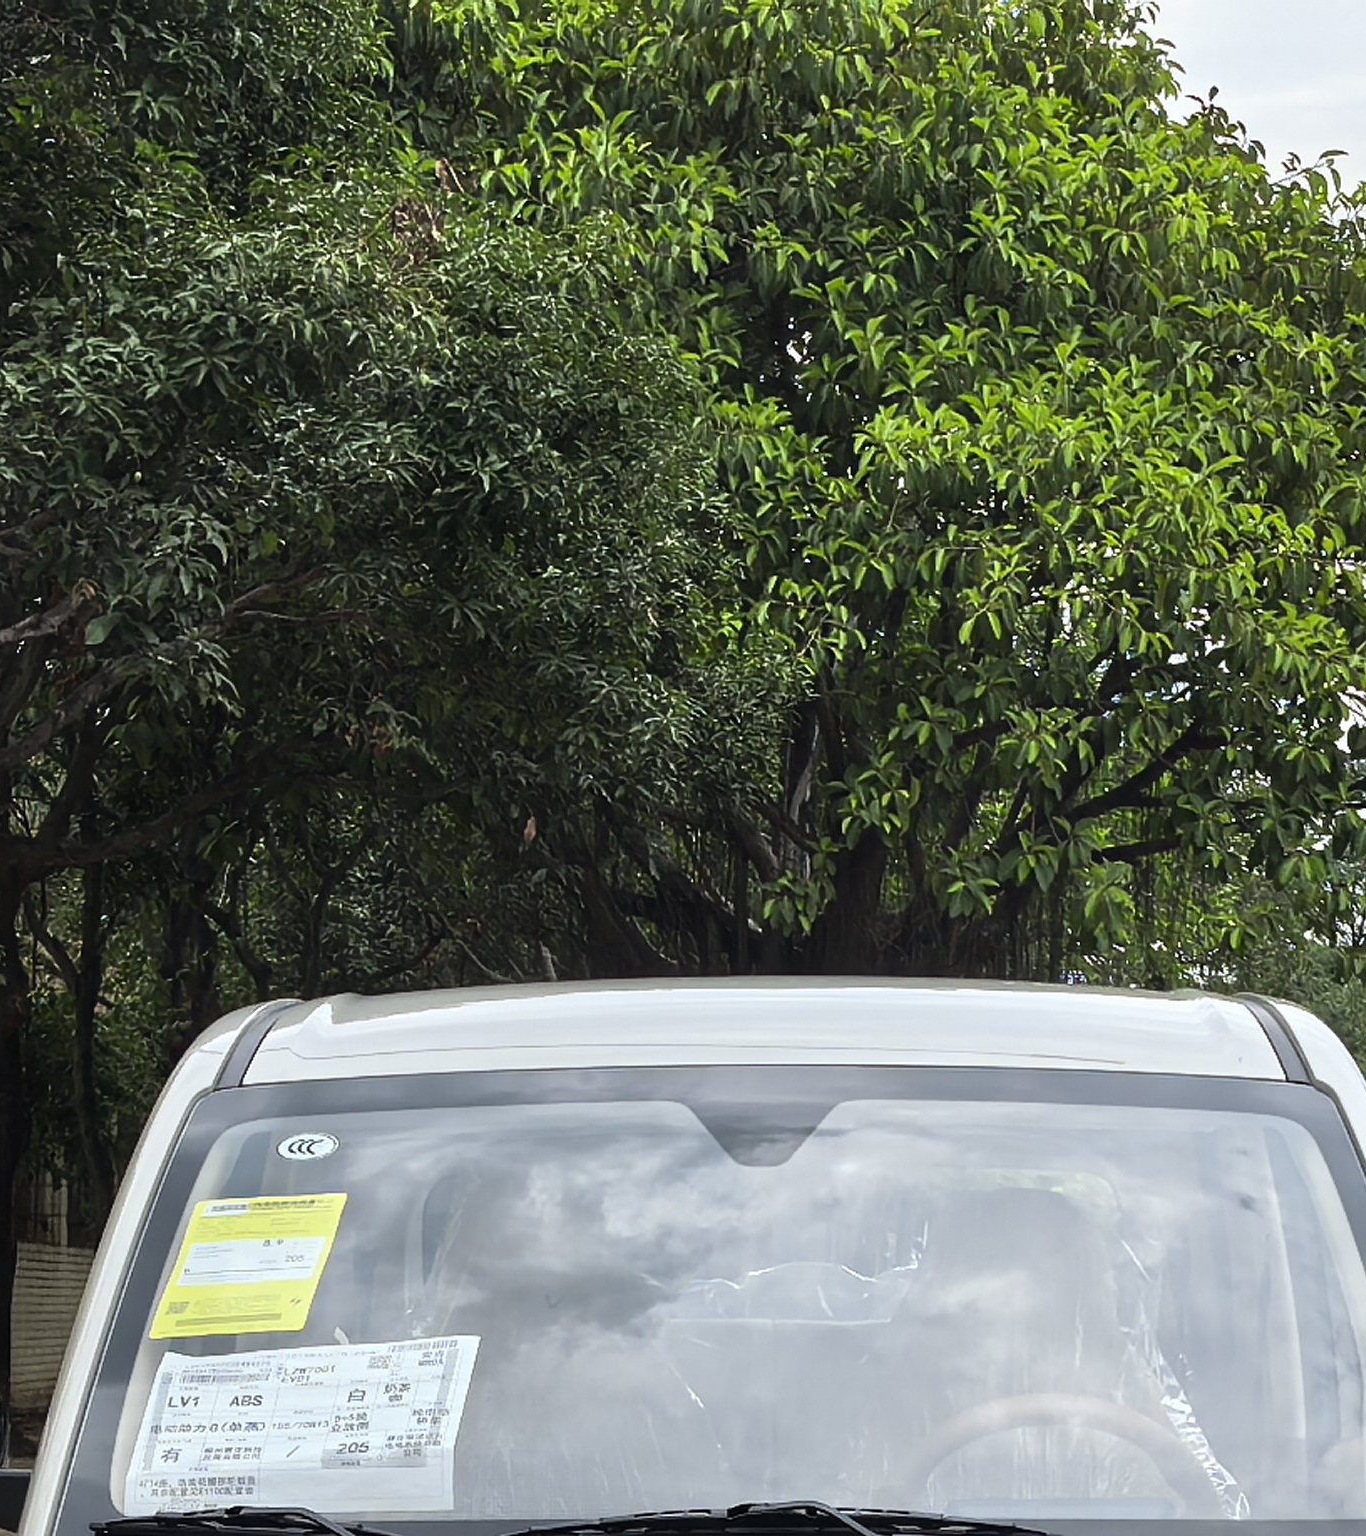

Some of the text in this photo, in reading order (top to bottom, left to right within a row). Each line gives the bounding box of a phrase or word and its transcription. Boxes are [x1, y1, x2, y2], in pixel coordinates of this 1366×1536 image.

[168, 1395, 201, 1408] LV1
[229, 1394, 264, 1407] ABS
[347, 1388, 366, 1403] 白
[160, 1447, 182, 1463] 有
[336, 1441, 370, 1455] 205
